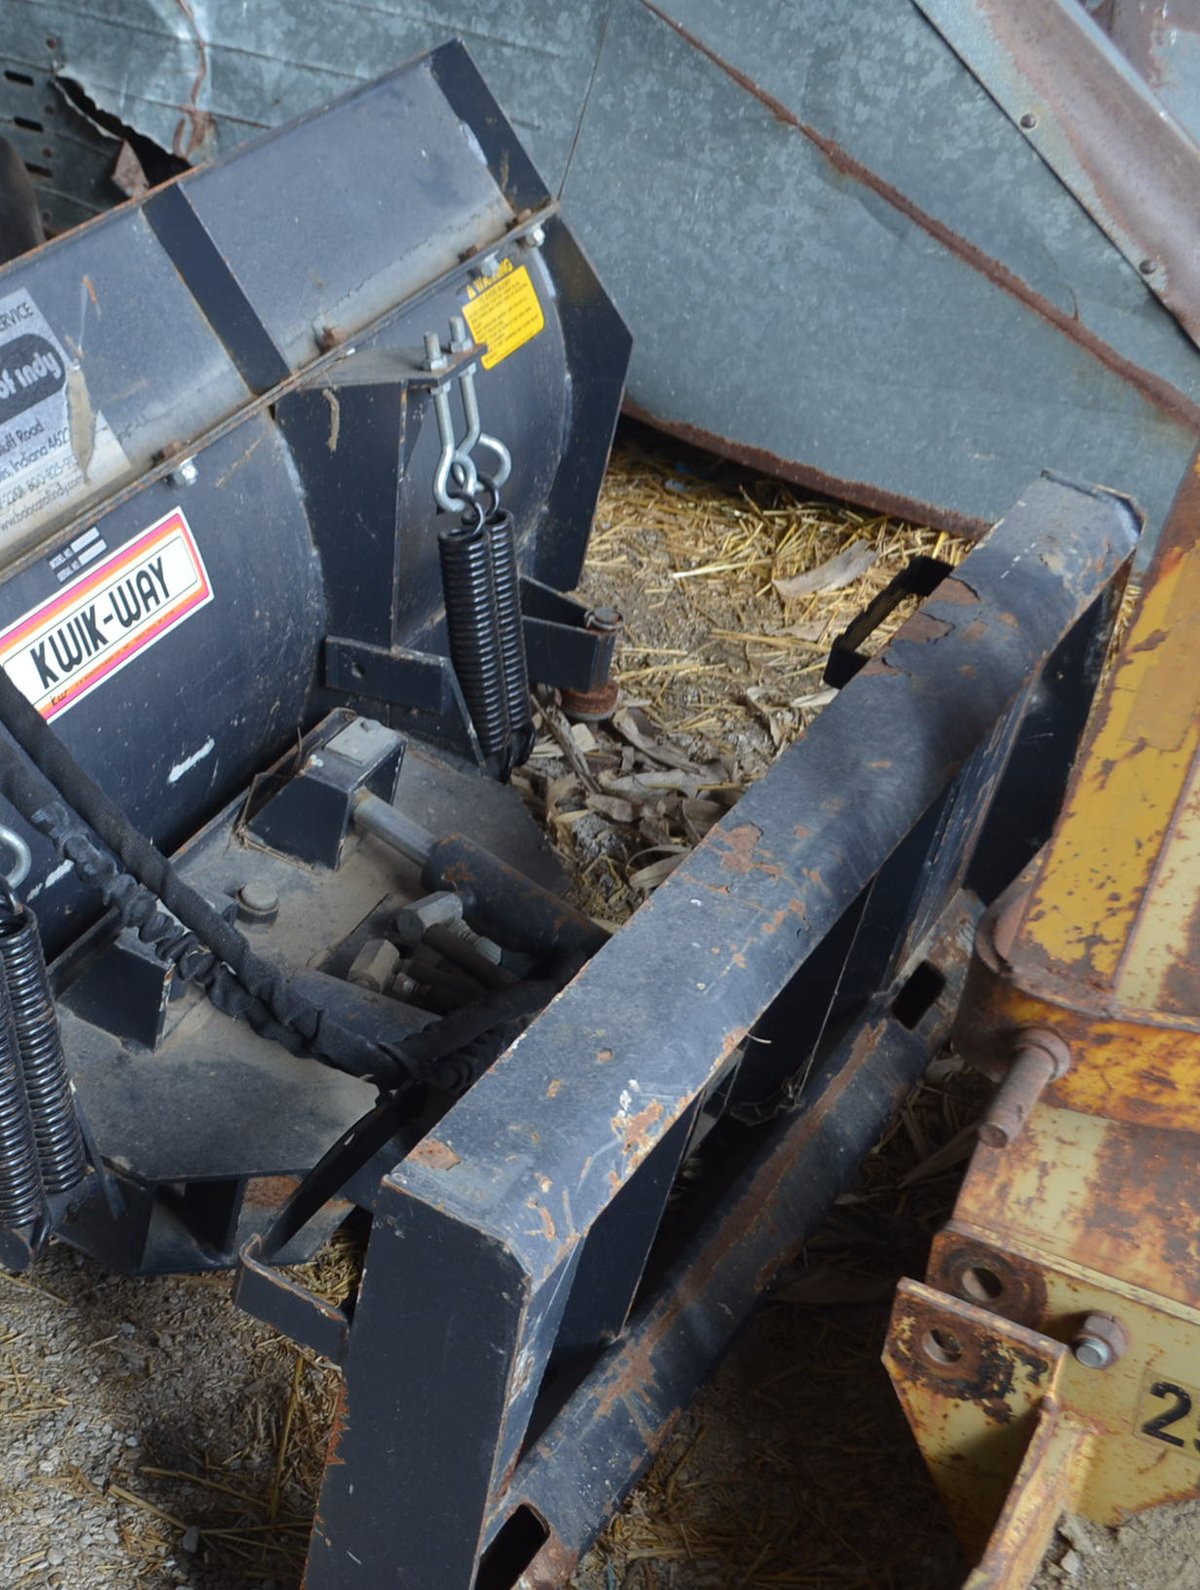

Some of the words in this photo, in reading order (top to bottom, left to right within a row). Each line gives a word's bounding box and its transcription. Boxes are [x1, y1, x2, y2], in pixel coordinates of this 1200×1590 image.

[14, 351, 62, 388] indy
[13, 417, 45, 443] Road
[8, 440, 49, 472] Indiana
[29, 556, 170, 690] KWIK-WAY
[1141, 1381, 1200, 1452] 2
